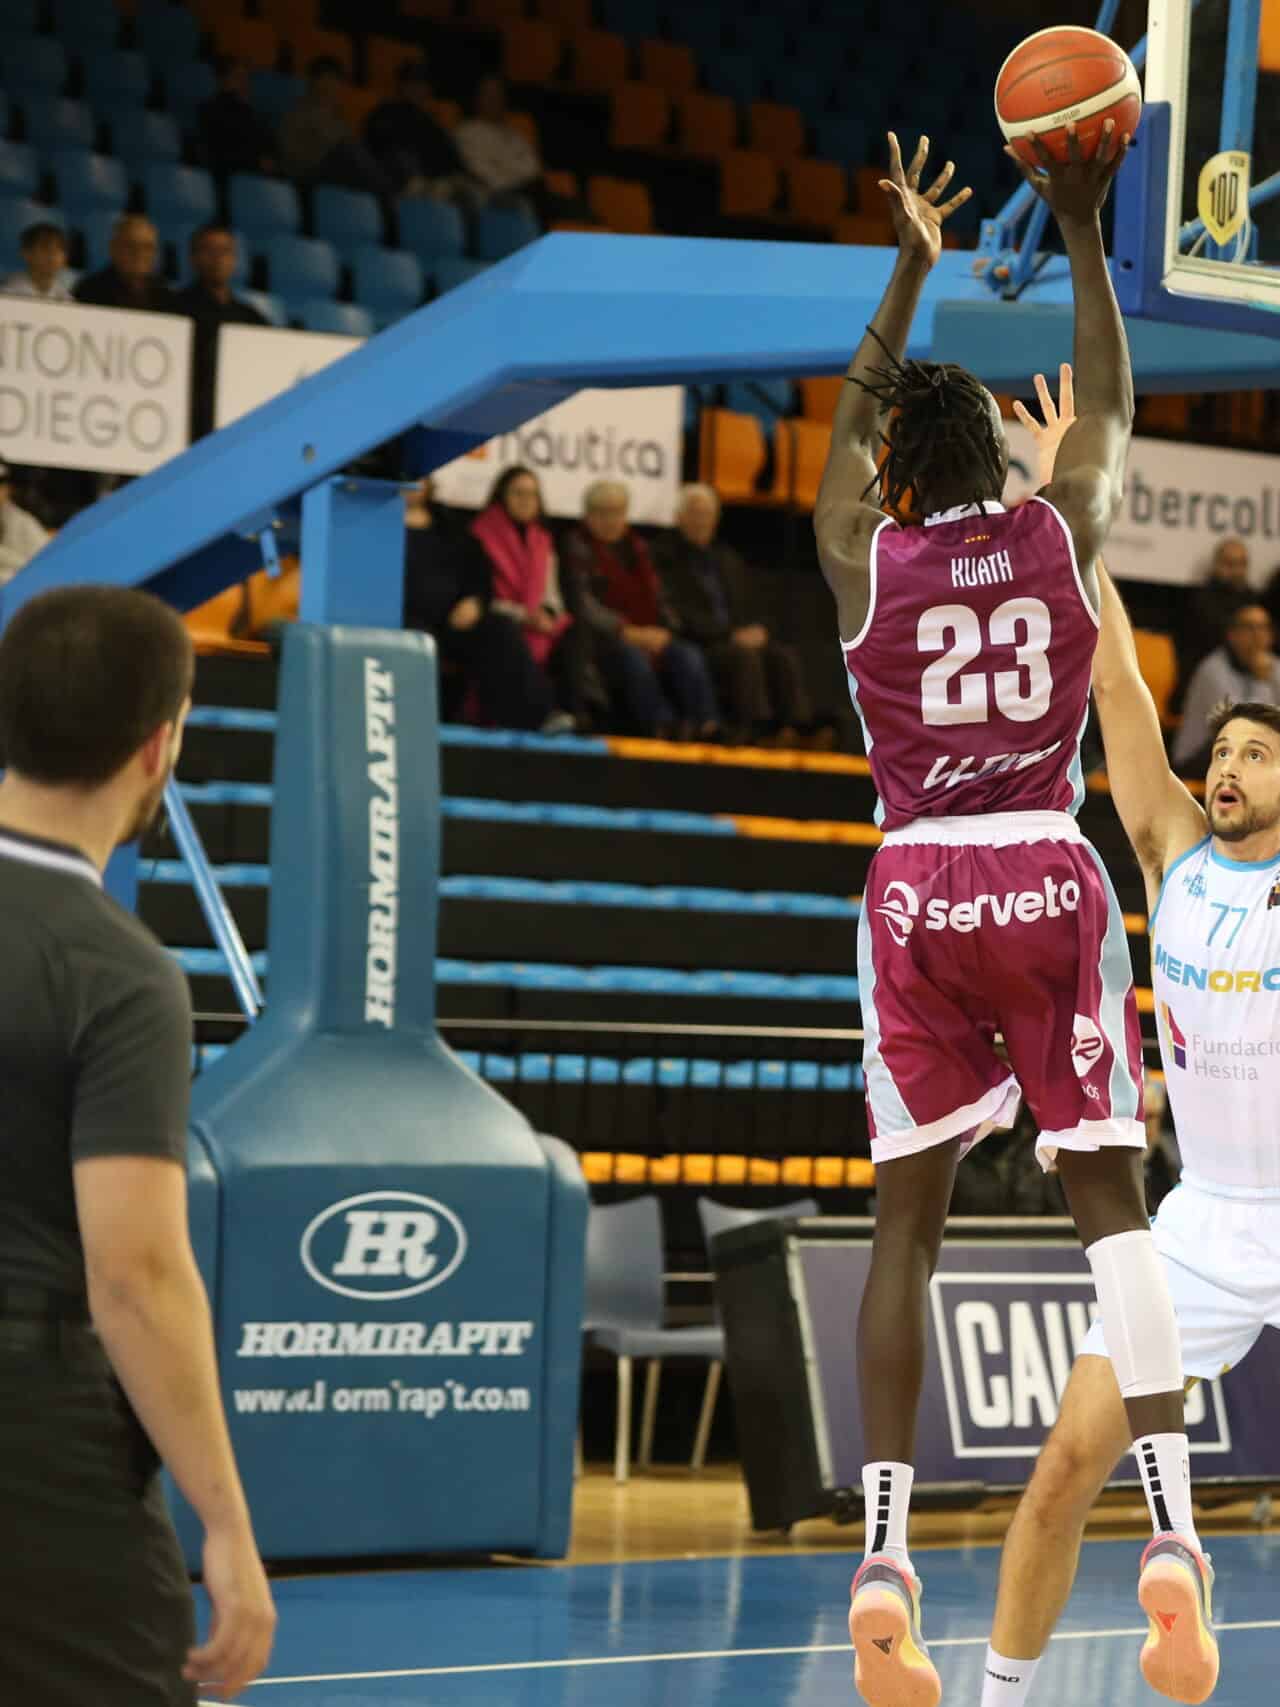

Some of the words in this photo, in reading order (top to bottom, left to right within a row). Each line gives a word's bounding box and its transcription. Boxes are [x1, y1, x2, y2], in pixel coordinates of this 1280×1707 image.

[0, 323, 173, 389] TONIO
[951, 550, 1014, 588] KUATH
[917, 597, 1053, 726] 23
[364, 656, 398, 1029] HORMIRAPIT
[925, 875, 1081, 933] serveto
[1206, 901, 1249, 949] 77
[1193, 1058, 1260, 1081] Hestia
[332, 1210, 438, 1279] HR
[235, 1321, 535, 1358] HORMIRAPIT
